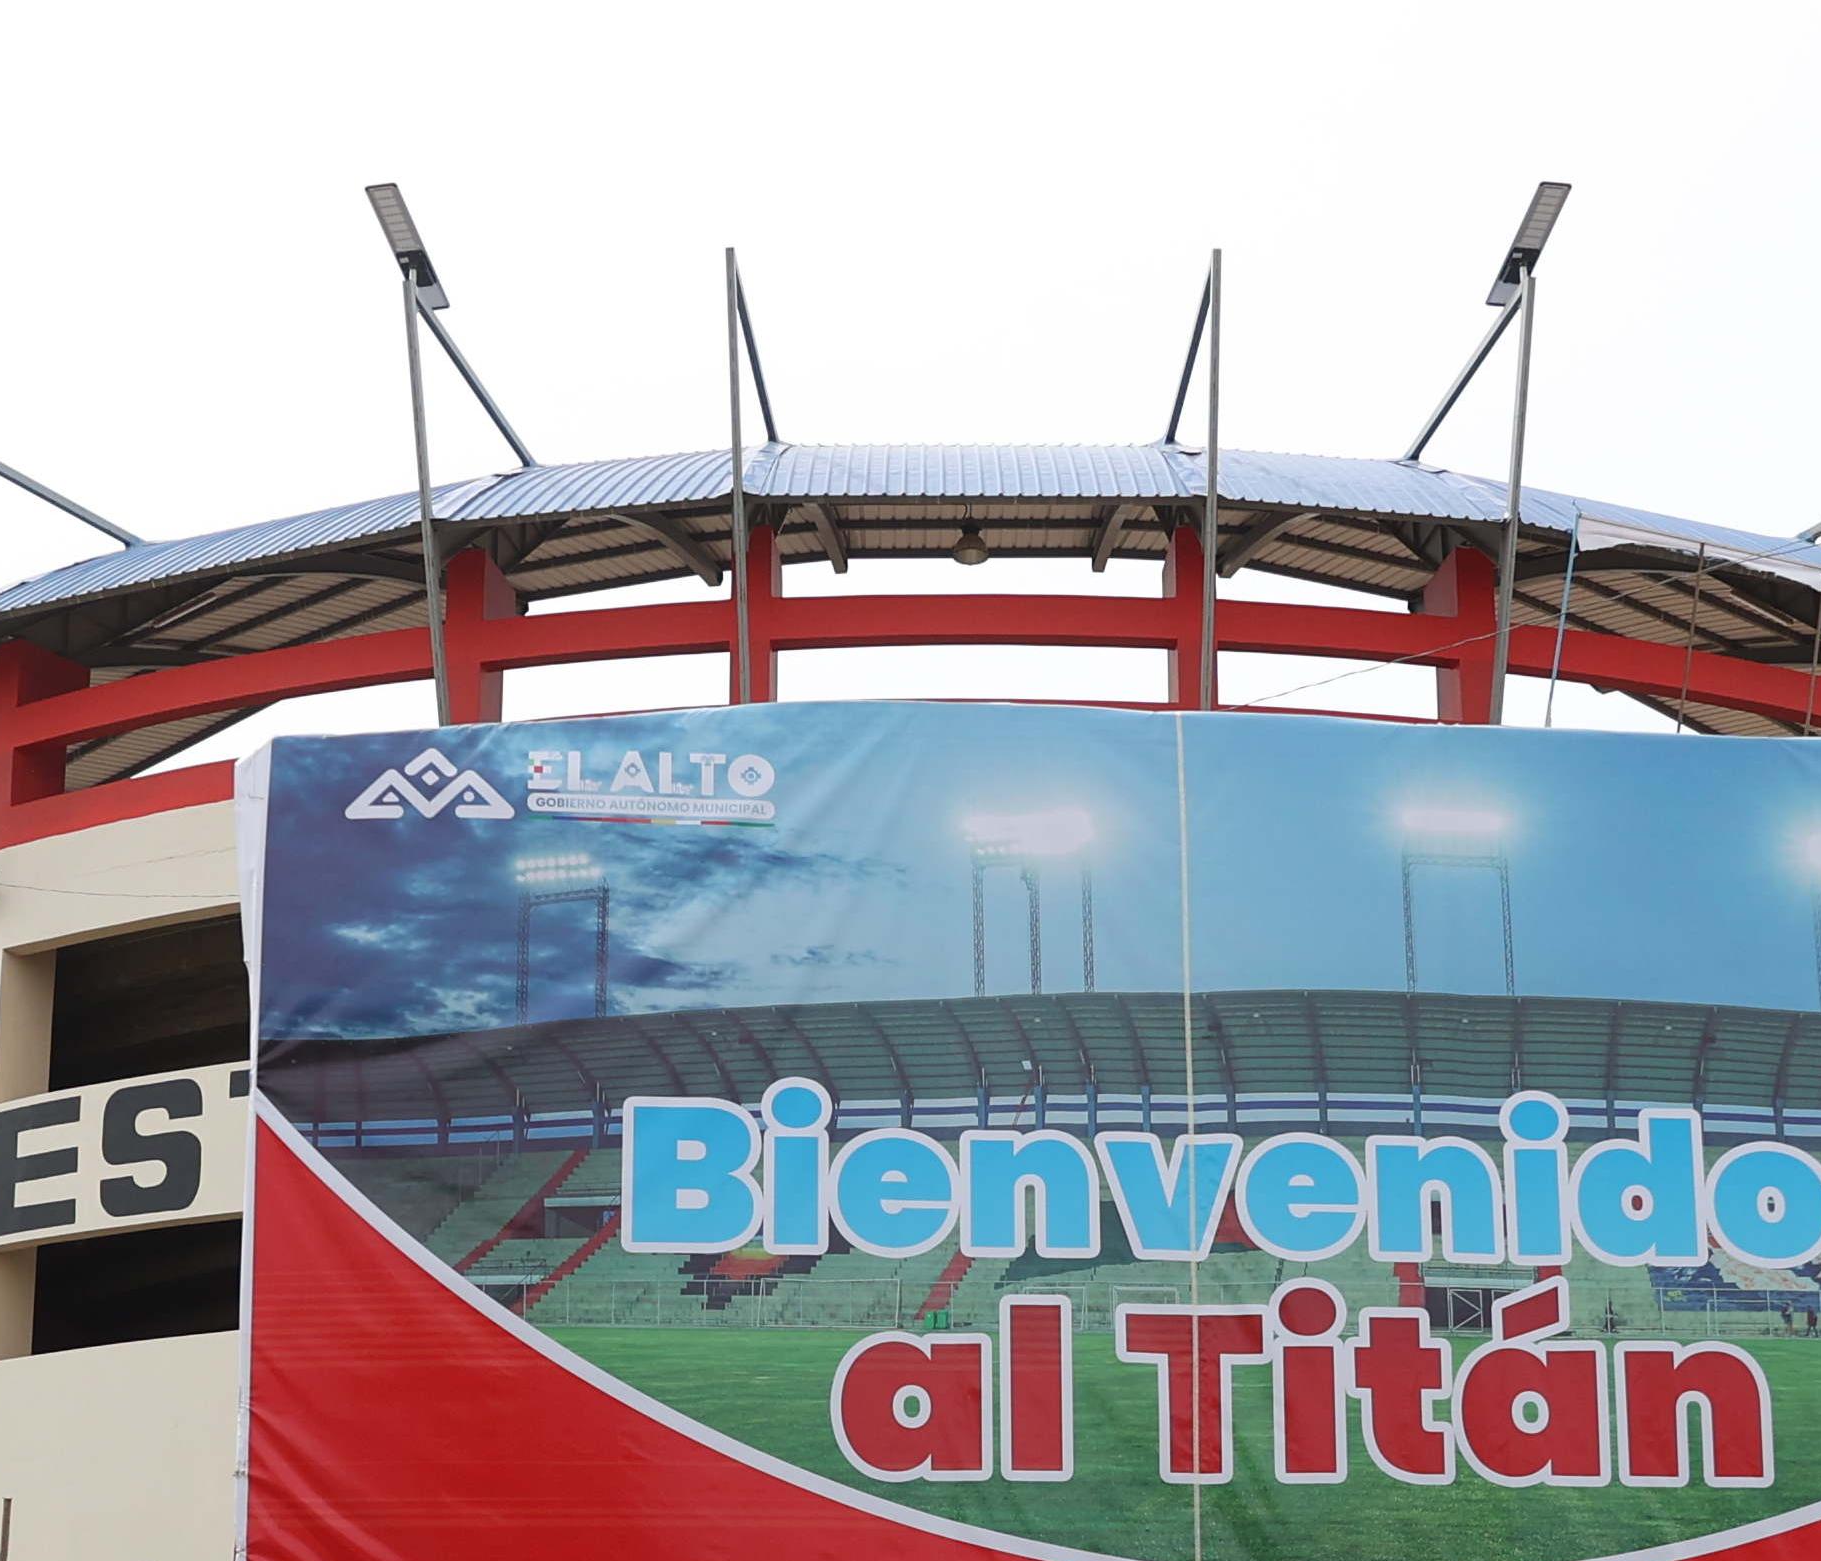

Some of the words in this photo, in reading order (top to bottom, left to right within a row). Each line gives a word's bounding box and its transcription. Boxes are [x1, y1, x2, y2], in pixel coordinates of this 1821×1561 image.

[528, 750, 581, 791] EL
[610, 751, 776, 798] ALTO
[535, 797, 607, 810] GOBIERNO
[609, 796, 690, 814] AUTÓNOMO
[692, 803, 767, 816] MUNICIPAL
[830, 1292, 1073, 1483] al
[1114, 1276, 1775, 1488] Titán
